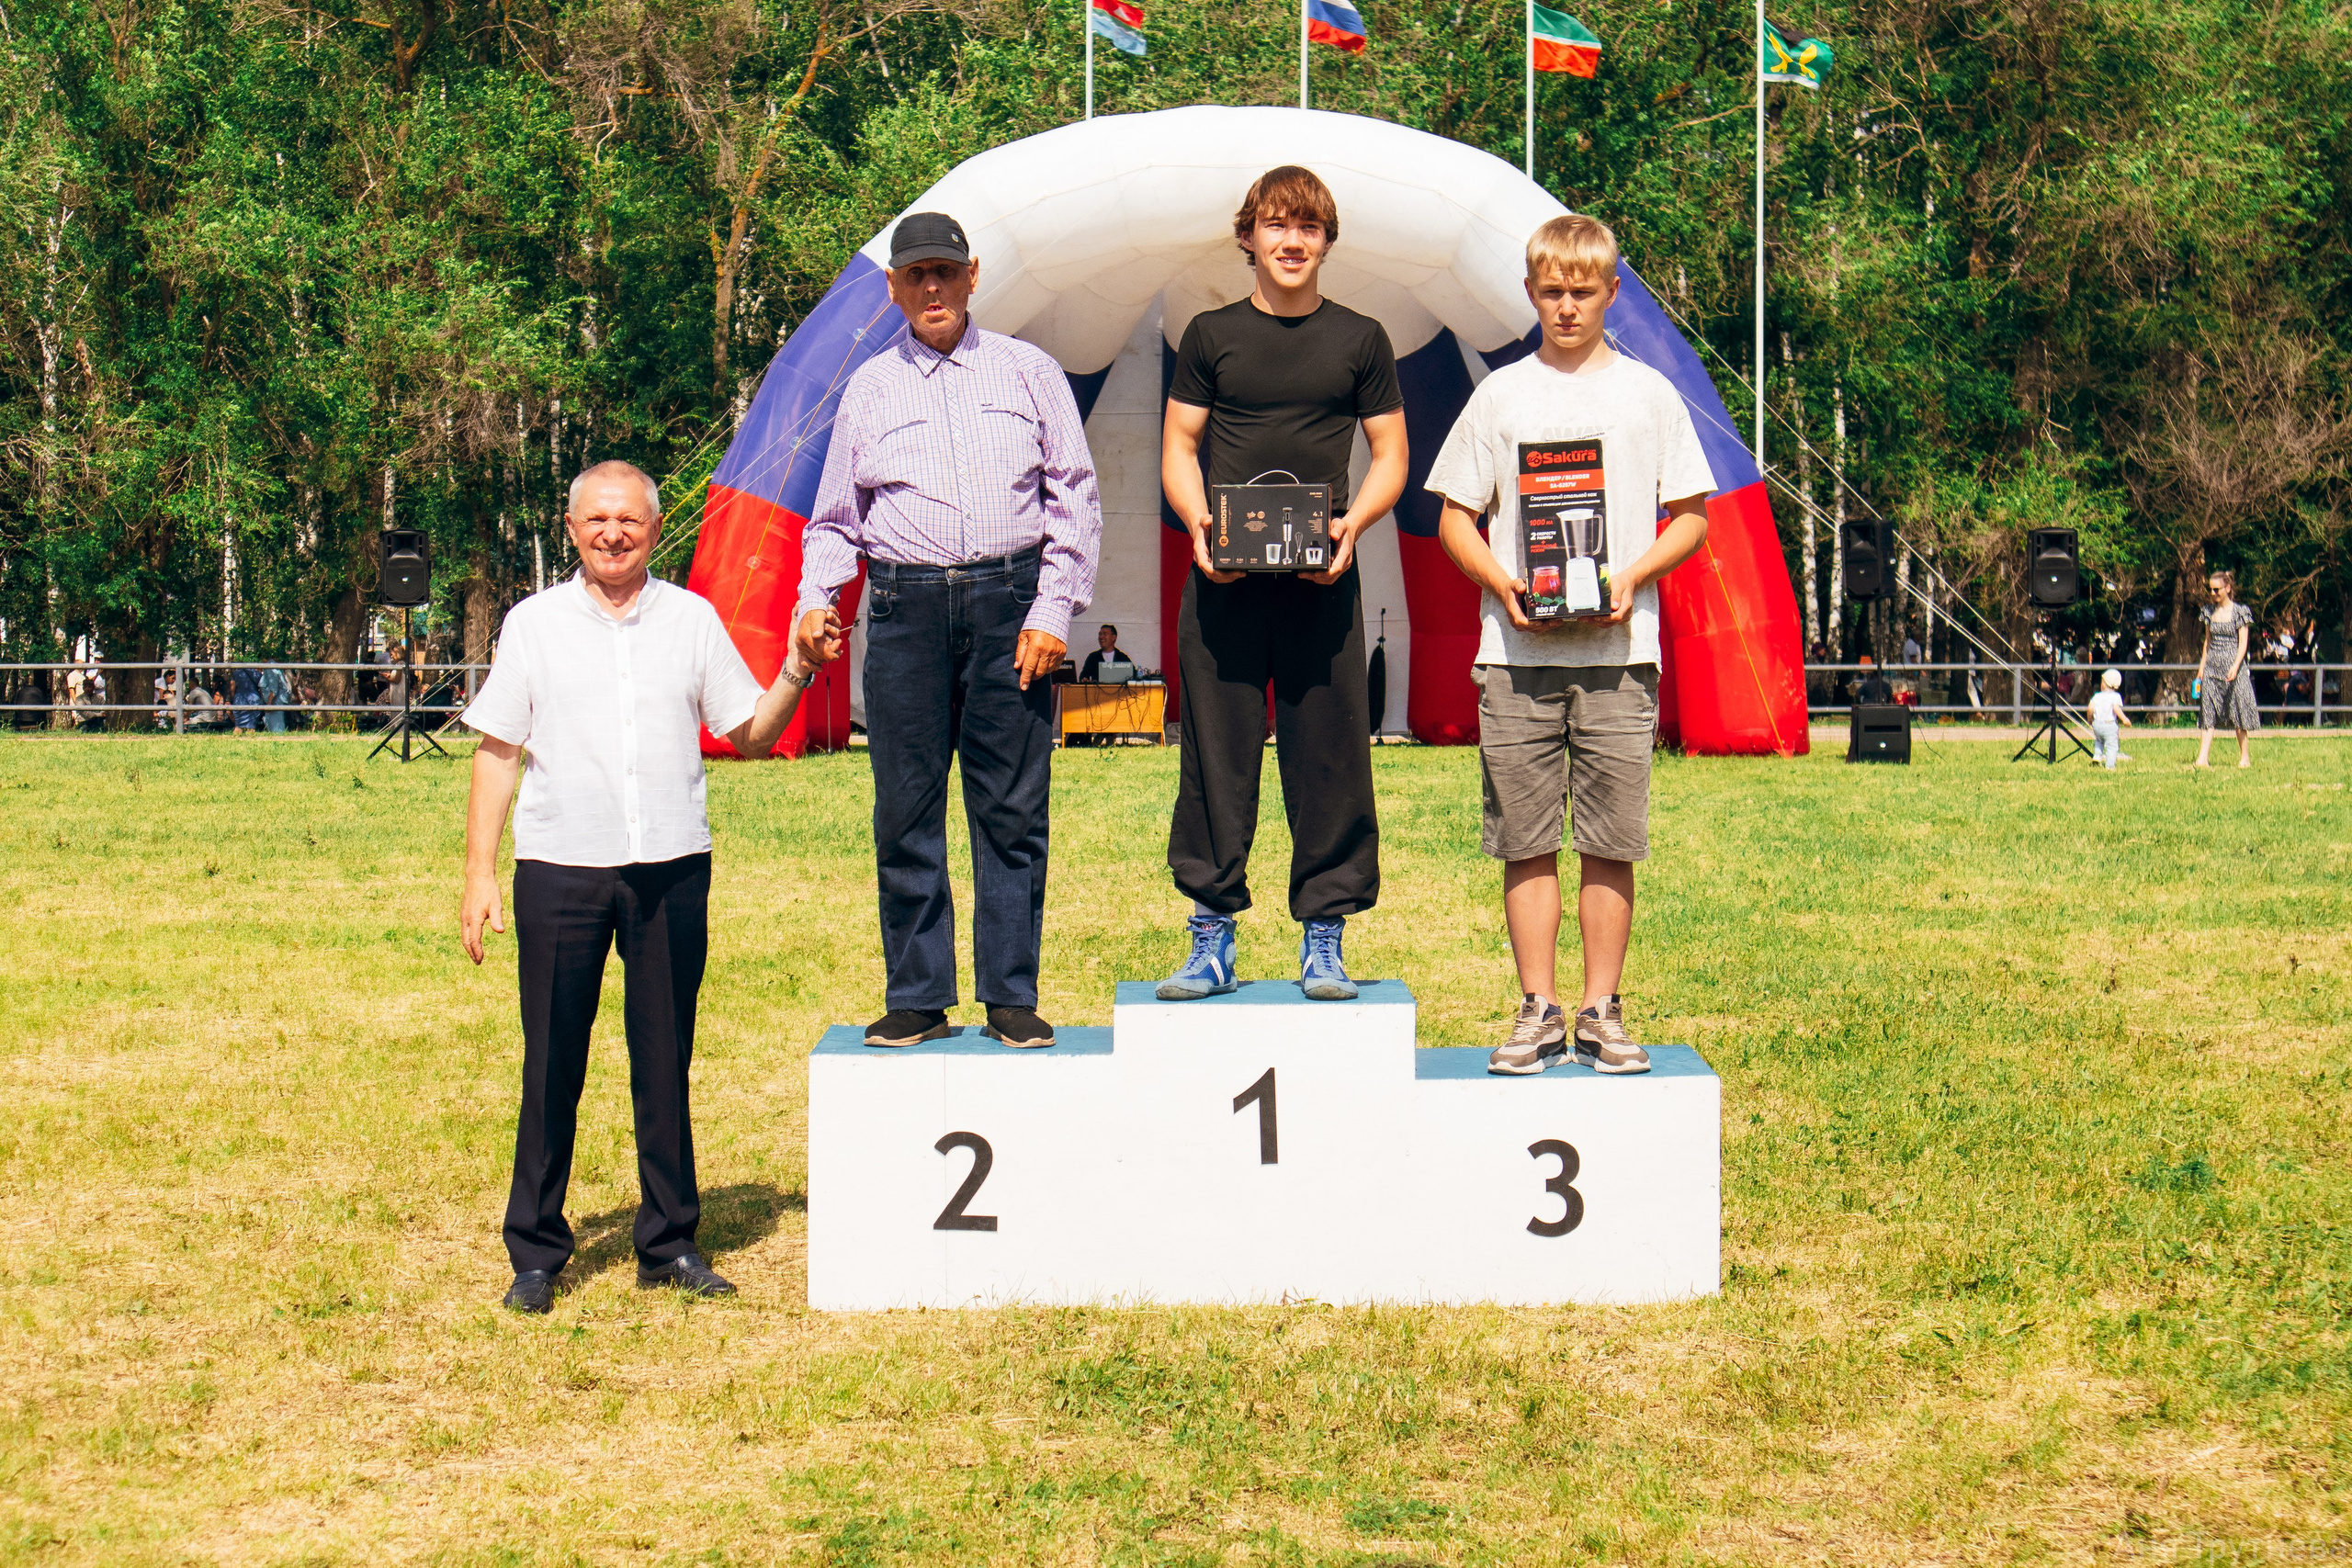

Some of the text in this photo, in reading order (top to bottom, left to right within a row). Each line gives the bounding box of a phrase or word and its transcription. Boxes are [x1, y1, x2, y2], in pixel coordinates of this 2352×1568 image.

[1543, 451, 1597, 464] Sakura
[1530, 518, 1545, 526] 1000
[1531, 532, 1536, 540] 2
[1234, 1067, 1278, 1164] 1
[933, 1132, 997, 1231] 2
[1527, 1140, 1583, 1237] 3
